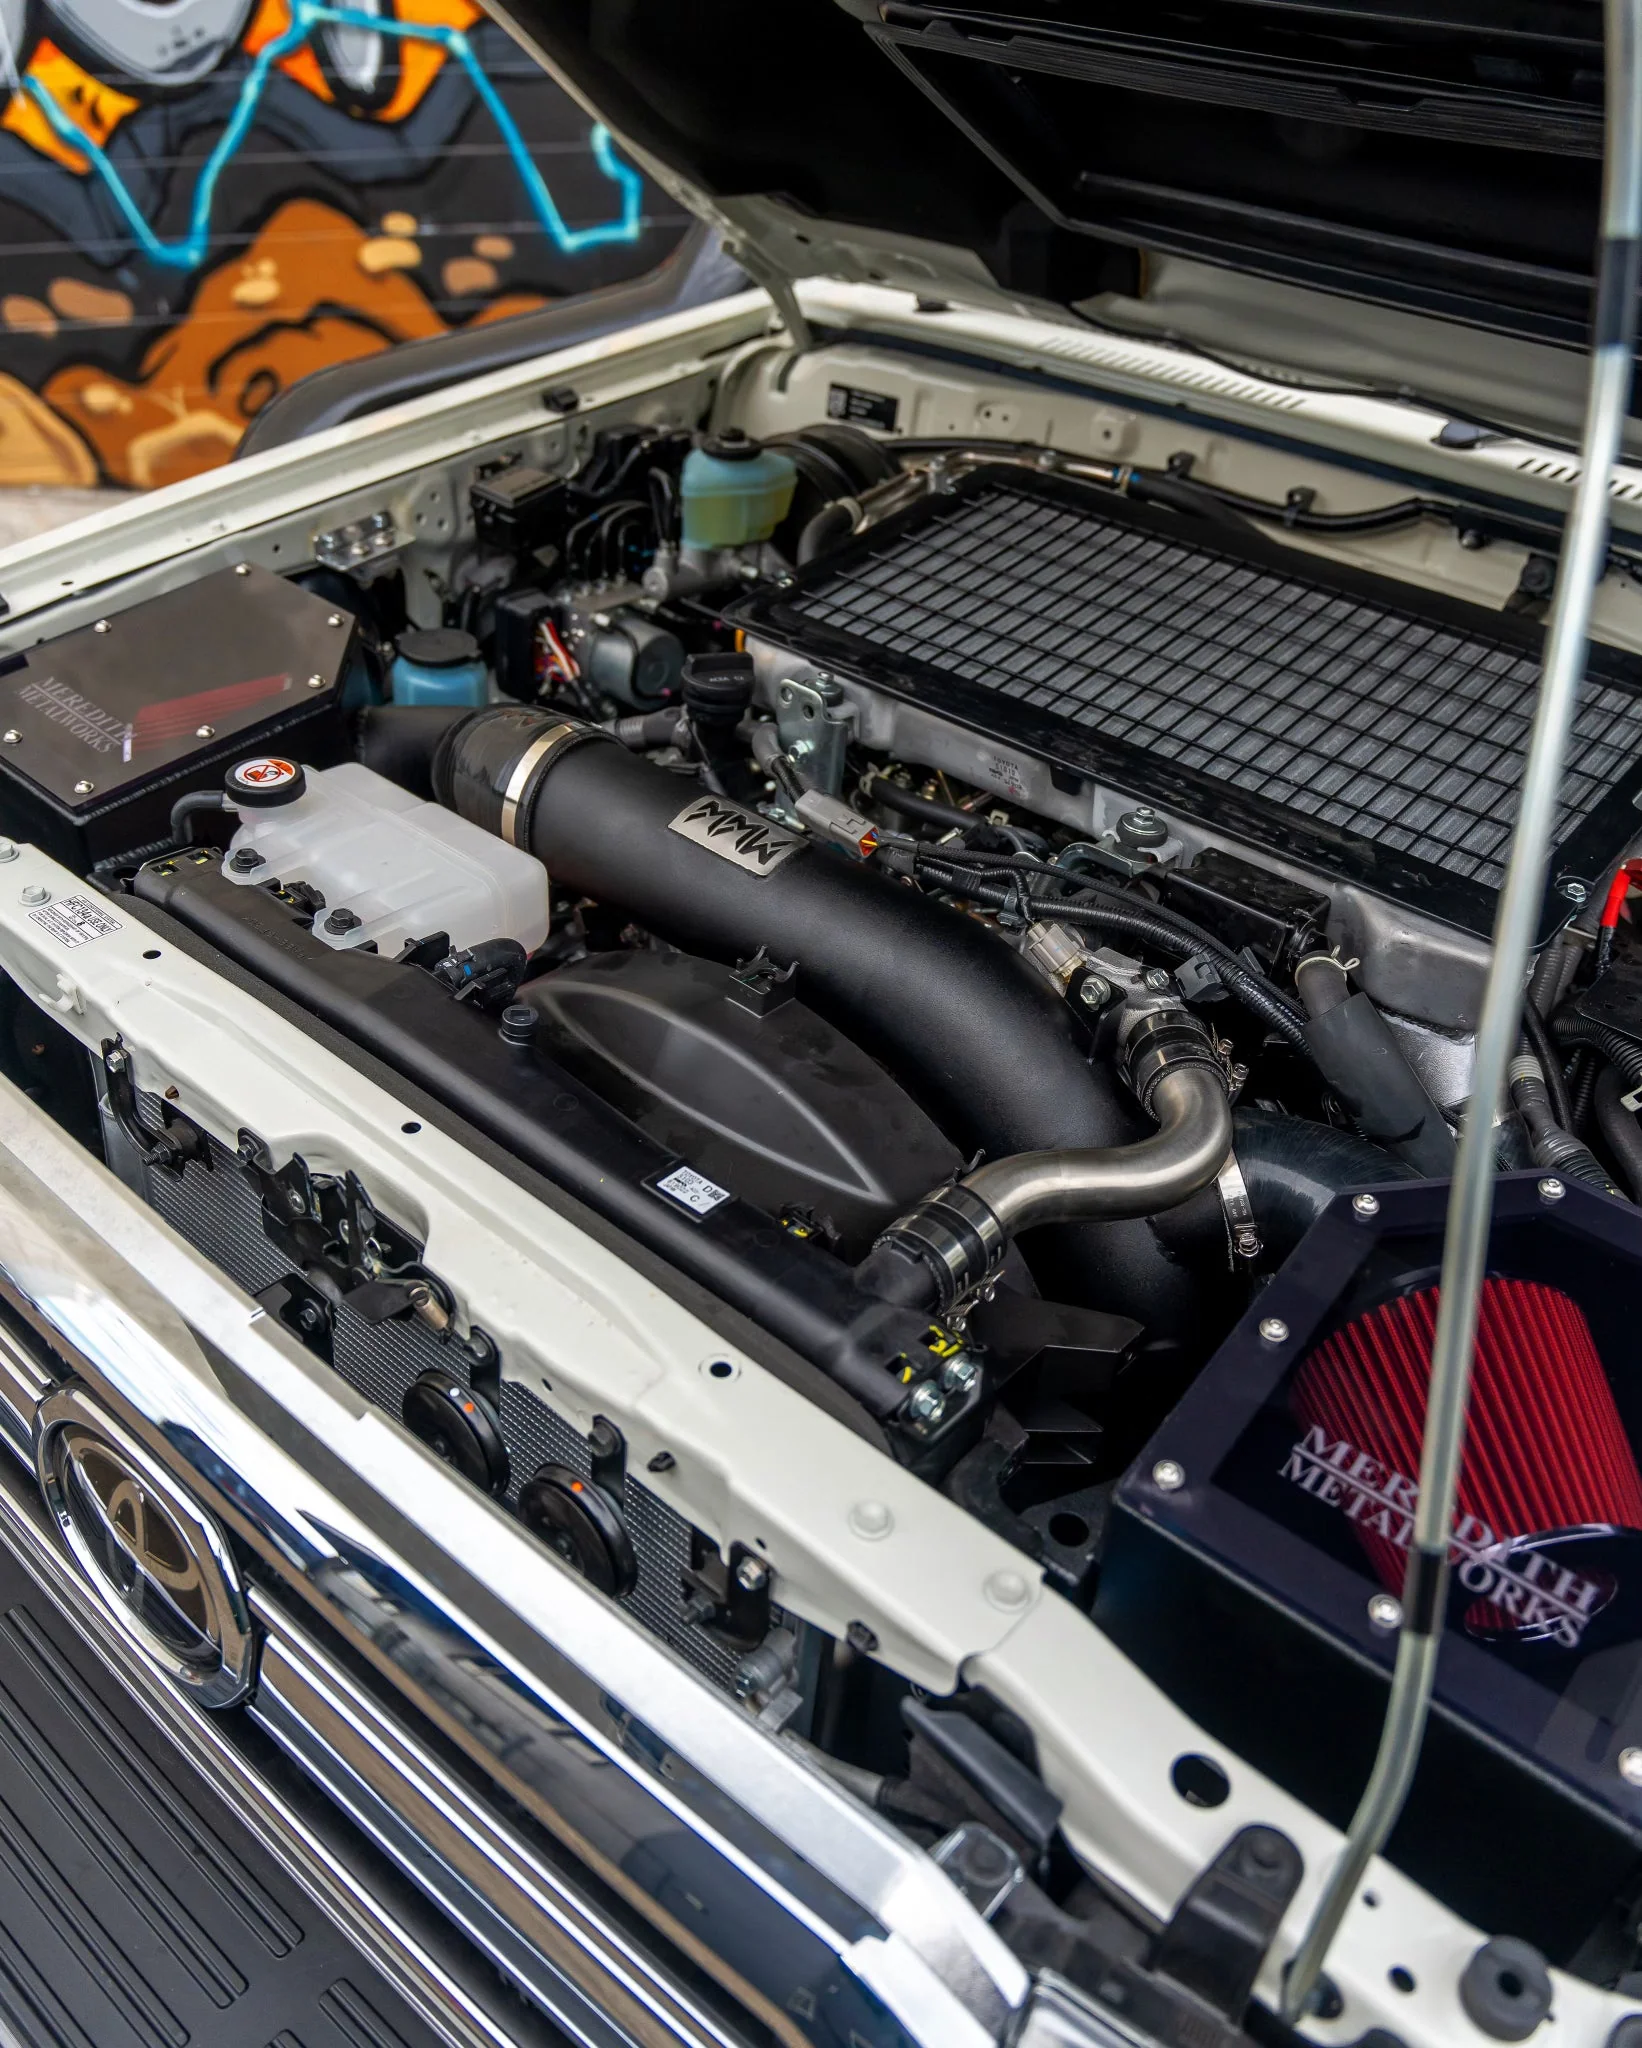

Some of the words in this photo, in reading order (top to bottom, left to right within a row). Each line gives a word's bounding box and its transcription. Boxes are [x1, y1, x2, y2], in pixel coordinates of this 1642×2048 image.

[19, 685, 114, 753] METALWORKS
[689, 1194, 700, 1202] C
[702, 1185, 713, 1193] D
[1278, 1454, 1583, 1648] METALORKS
[1300, 1425, 1600, 1612] MERDITH
